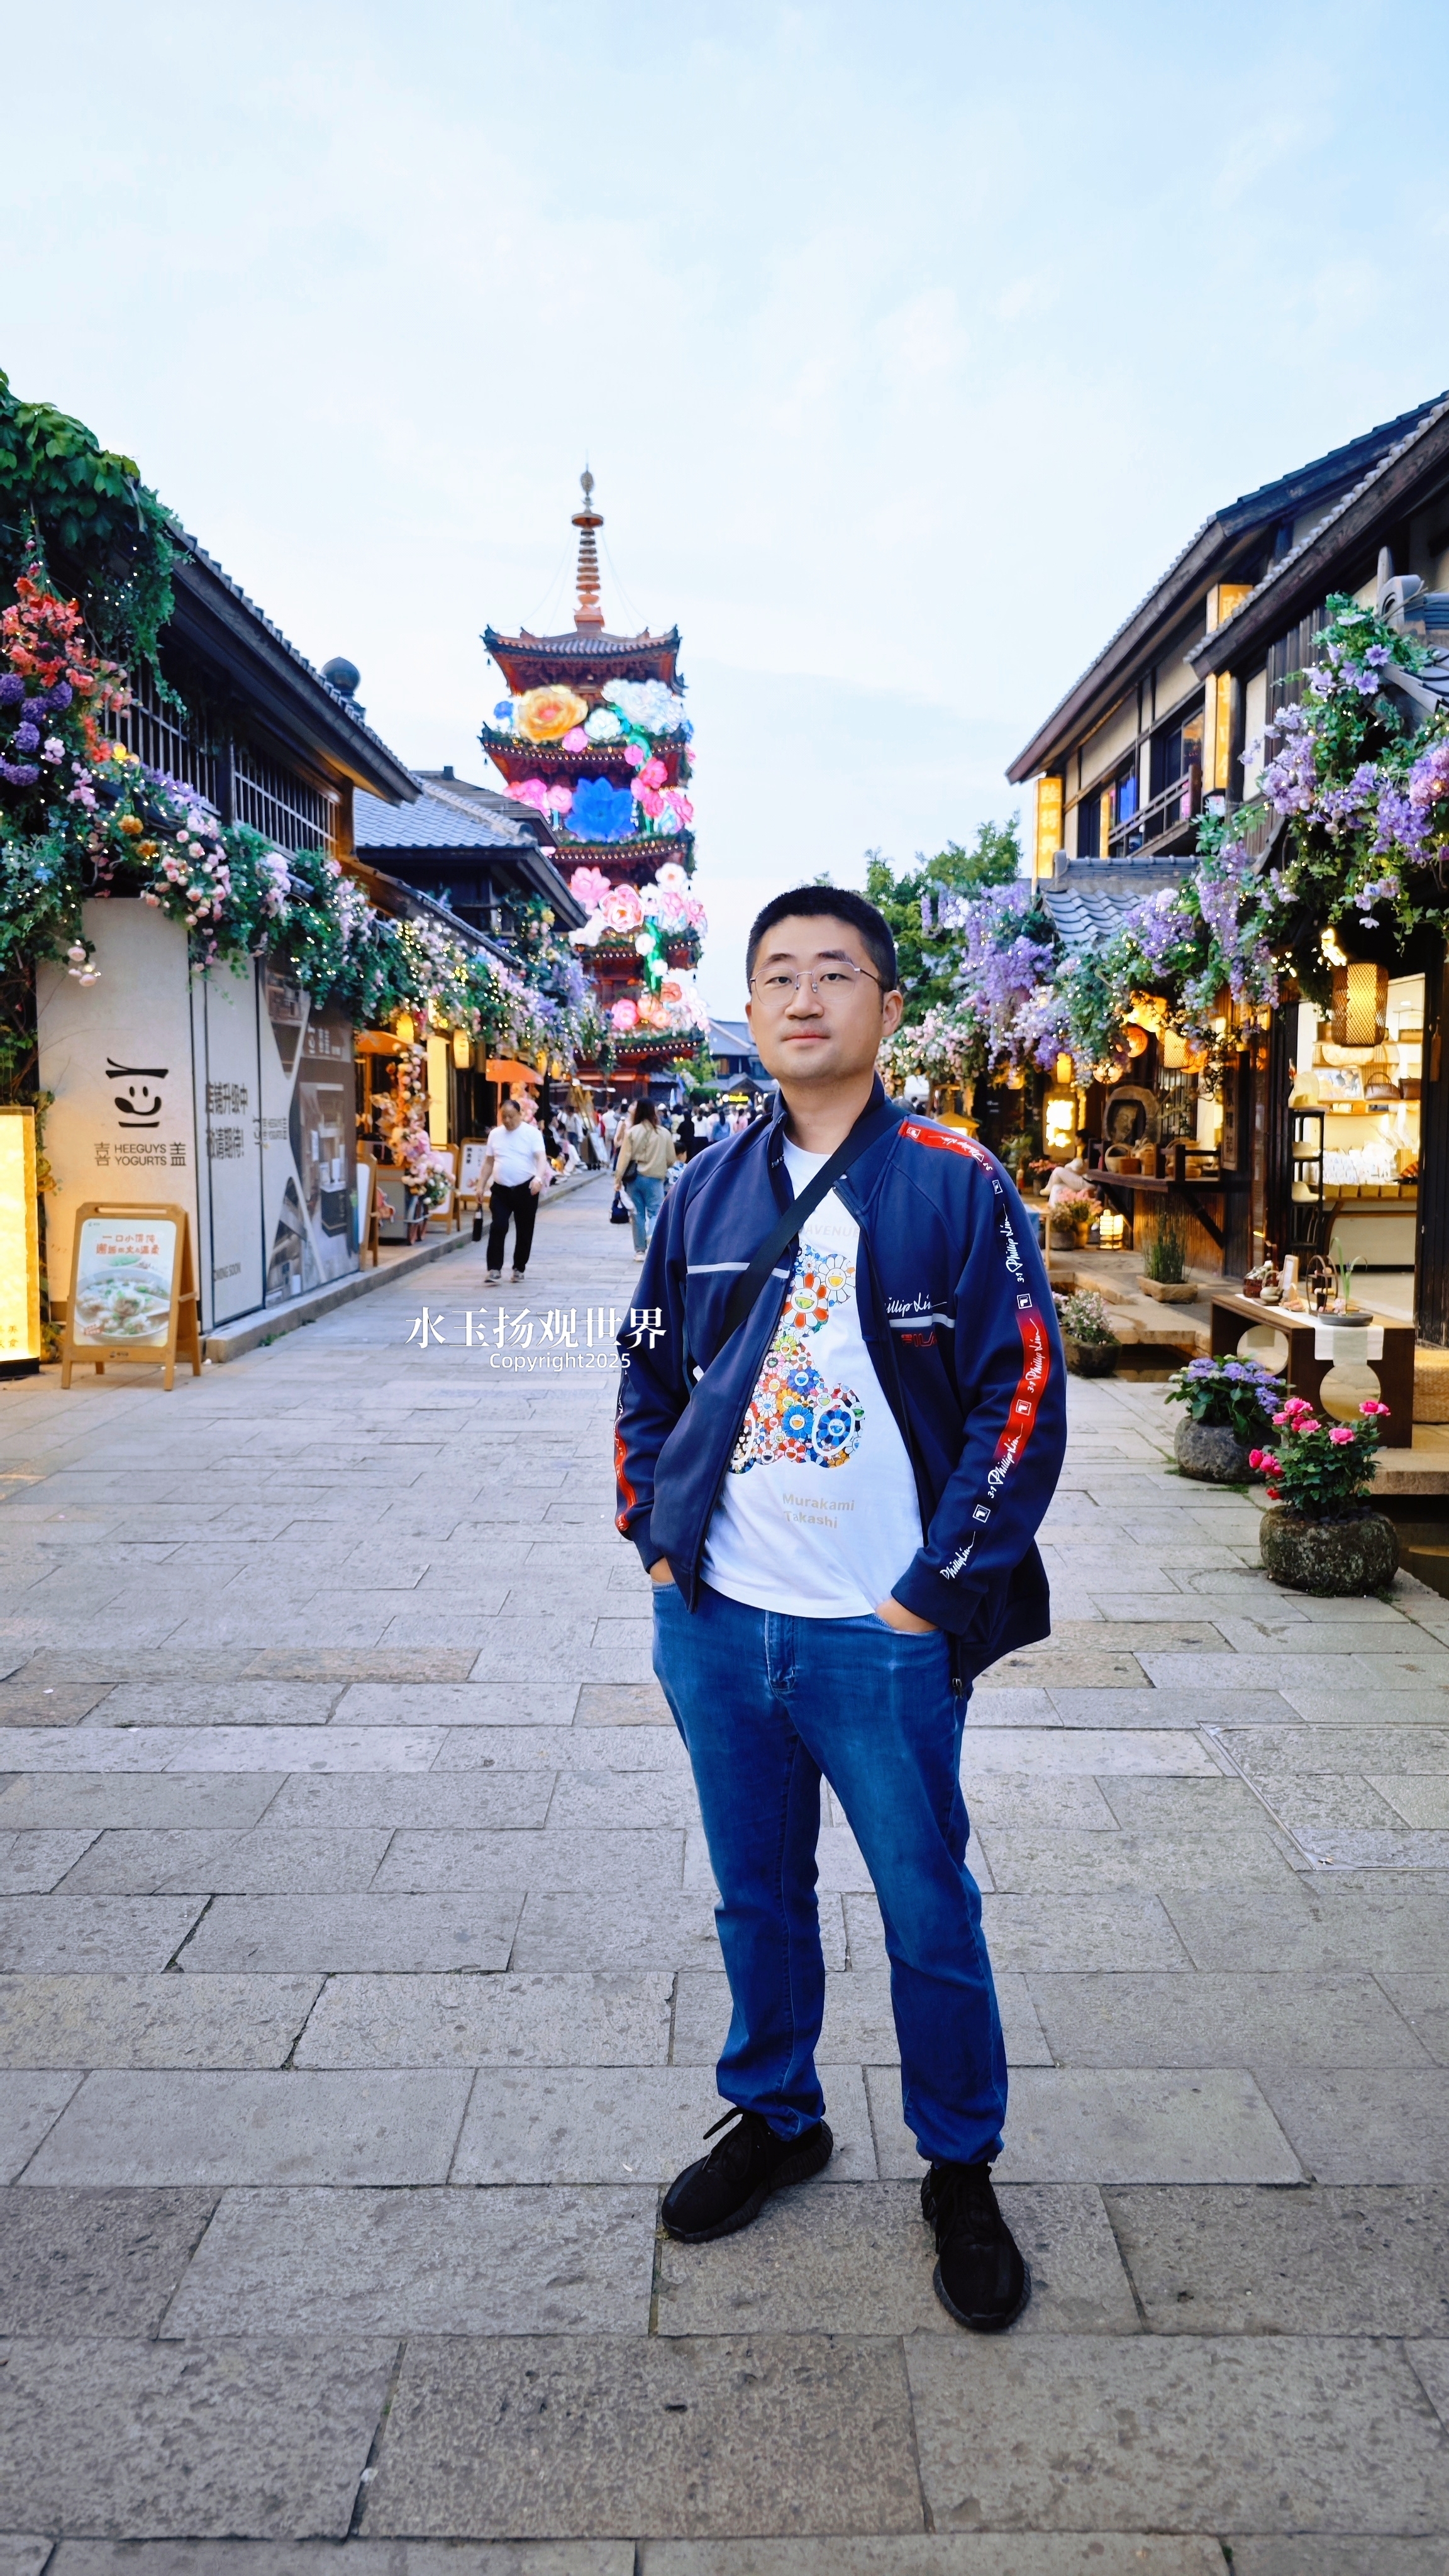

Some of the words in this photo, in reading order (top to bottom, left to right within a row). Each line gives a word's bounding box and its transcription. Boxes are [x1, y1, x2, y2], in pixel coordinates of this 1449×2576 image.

[114, 1143, 167, 1154] HEEGUYS
[115, 1156, 167, 1166] YOGURTS
[1000, 1203, 1014, 1237] Lim
[1006, 1237, 1023, 1273] Phillip
[1029, 1318, 1043, 1352] Lim
[1025, 1352, 1046, 1380] Phillip
[987, 1452, 1015, 1485] Phillip
[1004, 1423, 1023, 1453] Lim
[782, 1493, 855, 1511] Murakami
[784, 1510, 838, 1529] Takashi
